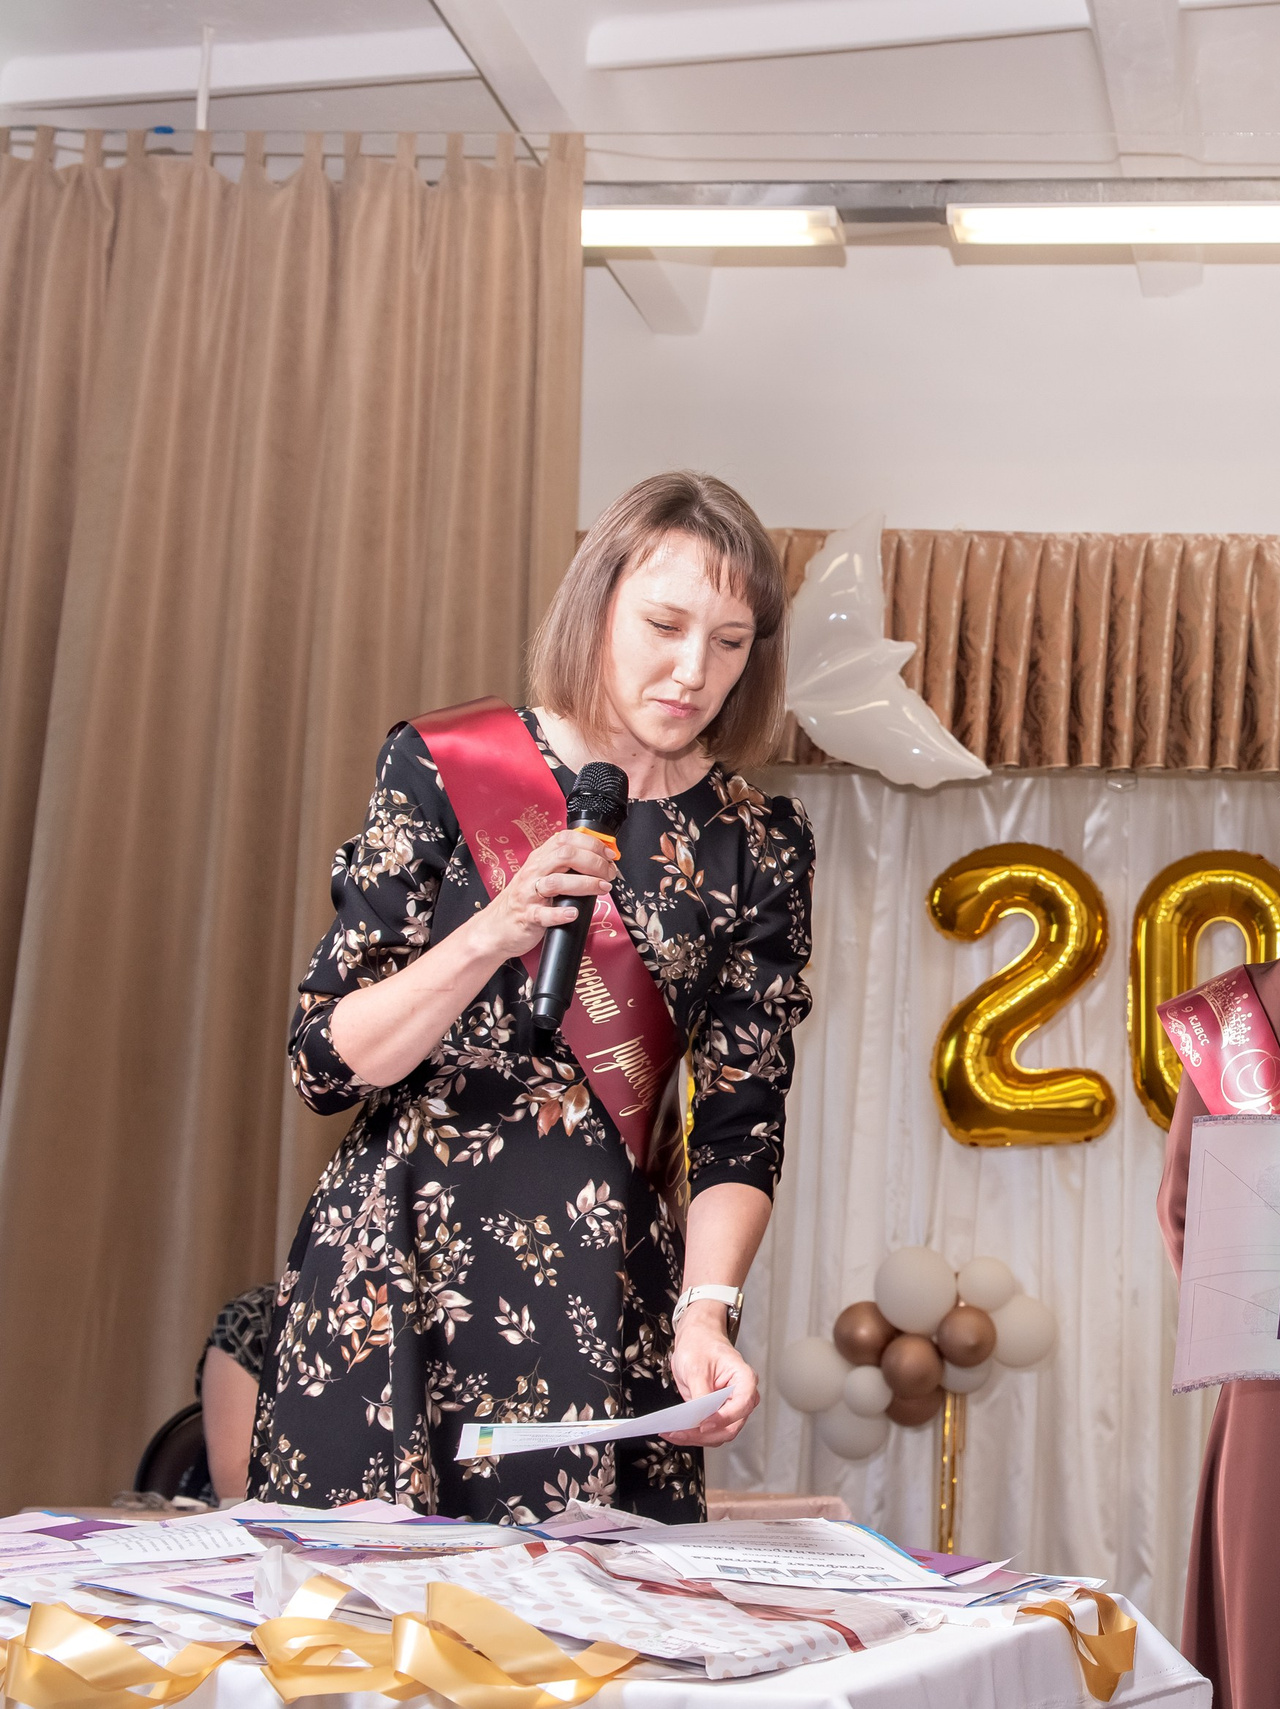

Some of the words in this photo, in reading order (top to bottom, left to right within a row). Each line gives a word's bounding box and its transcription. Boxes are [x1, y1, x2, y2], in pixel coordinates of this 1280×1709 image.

[494, 835, 510, 844] 9
[503, 849, 521, 873] кла
[1181, 1006, 1194, 1014] 9
[1188, 1015, 1210, 1047] класс
[586, 1034, 673, 1117] руковод
